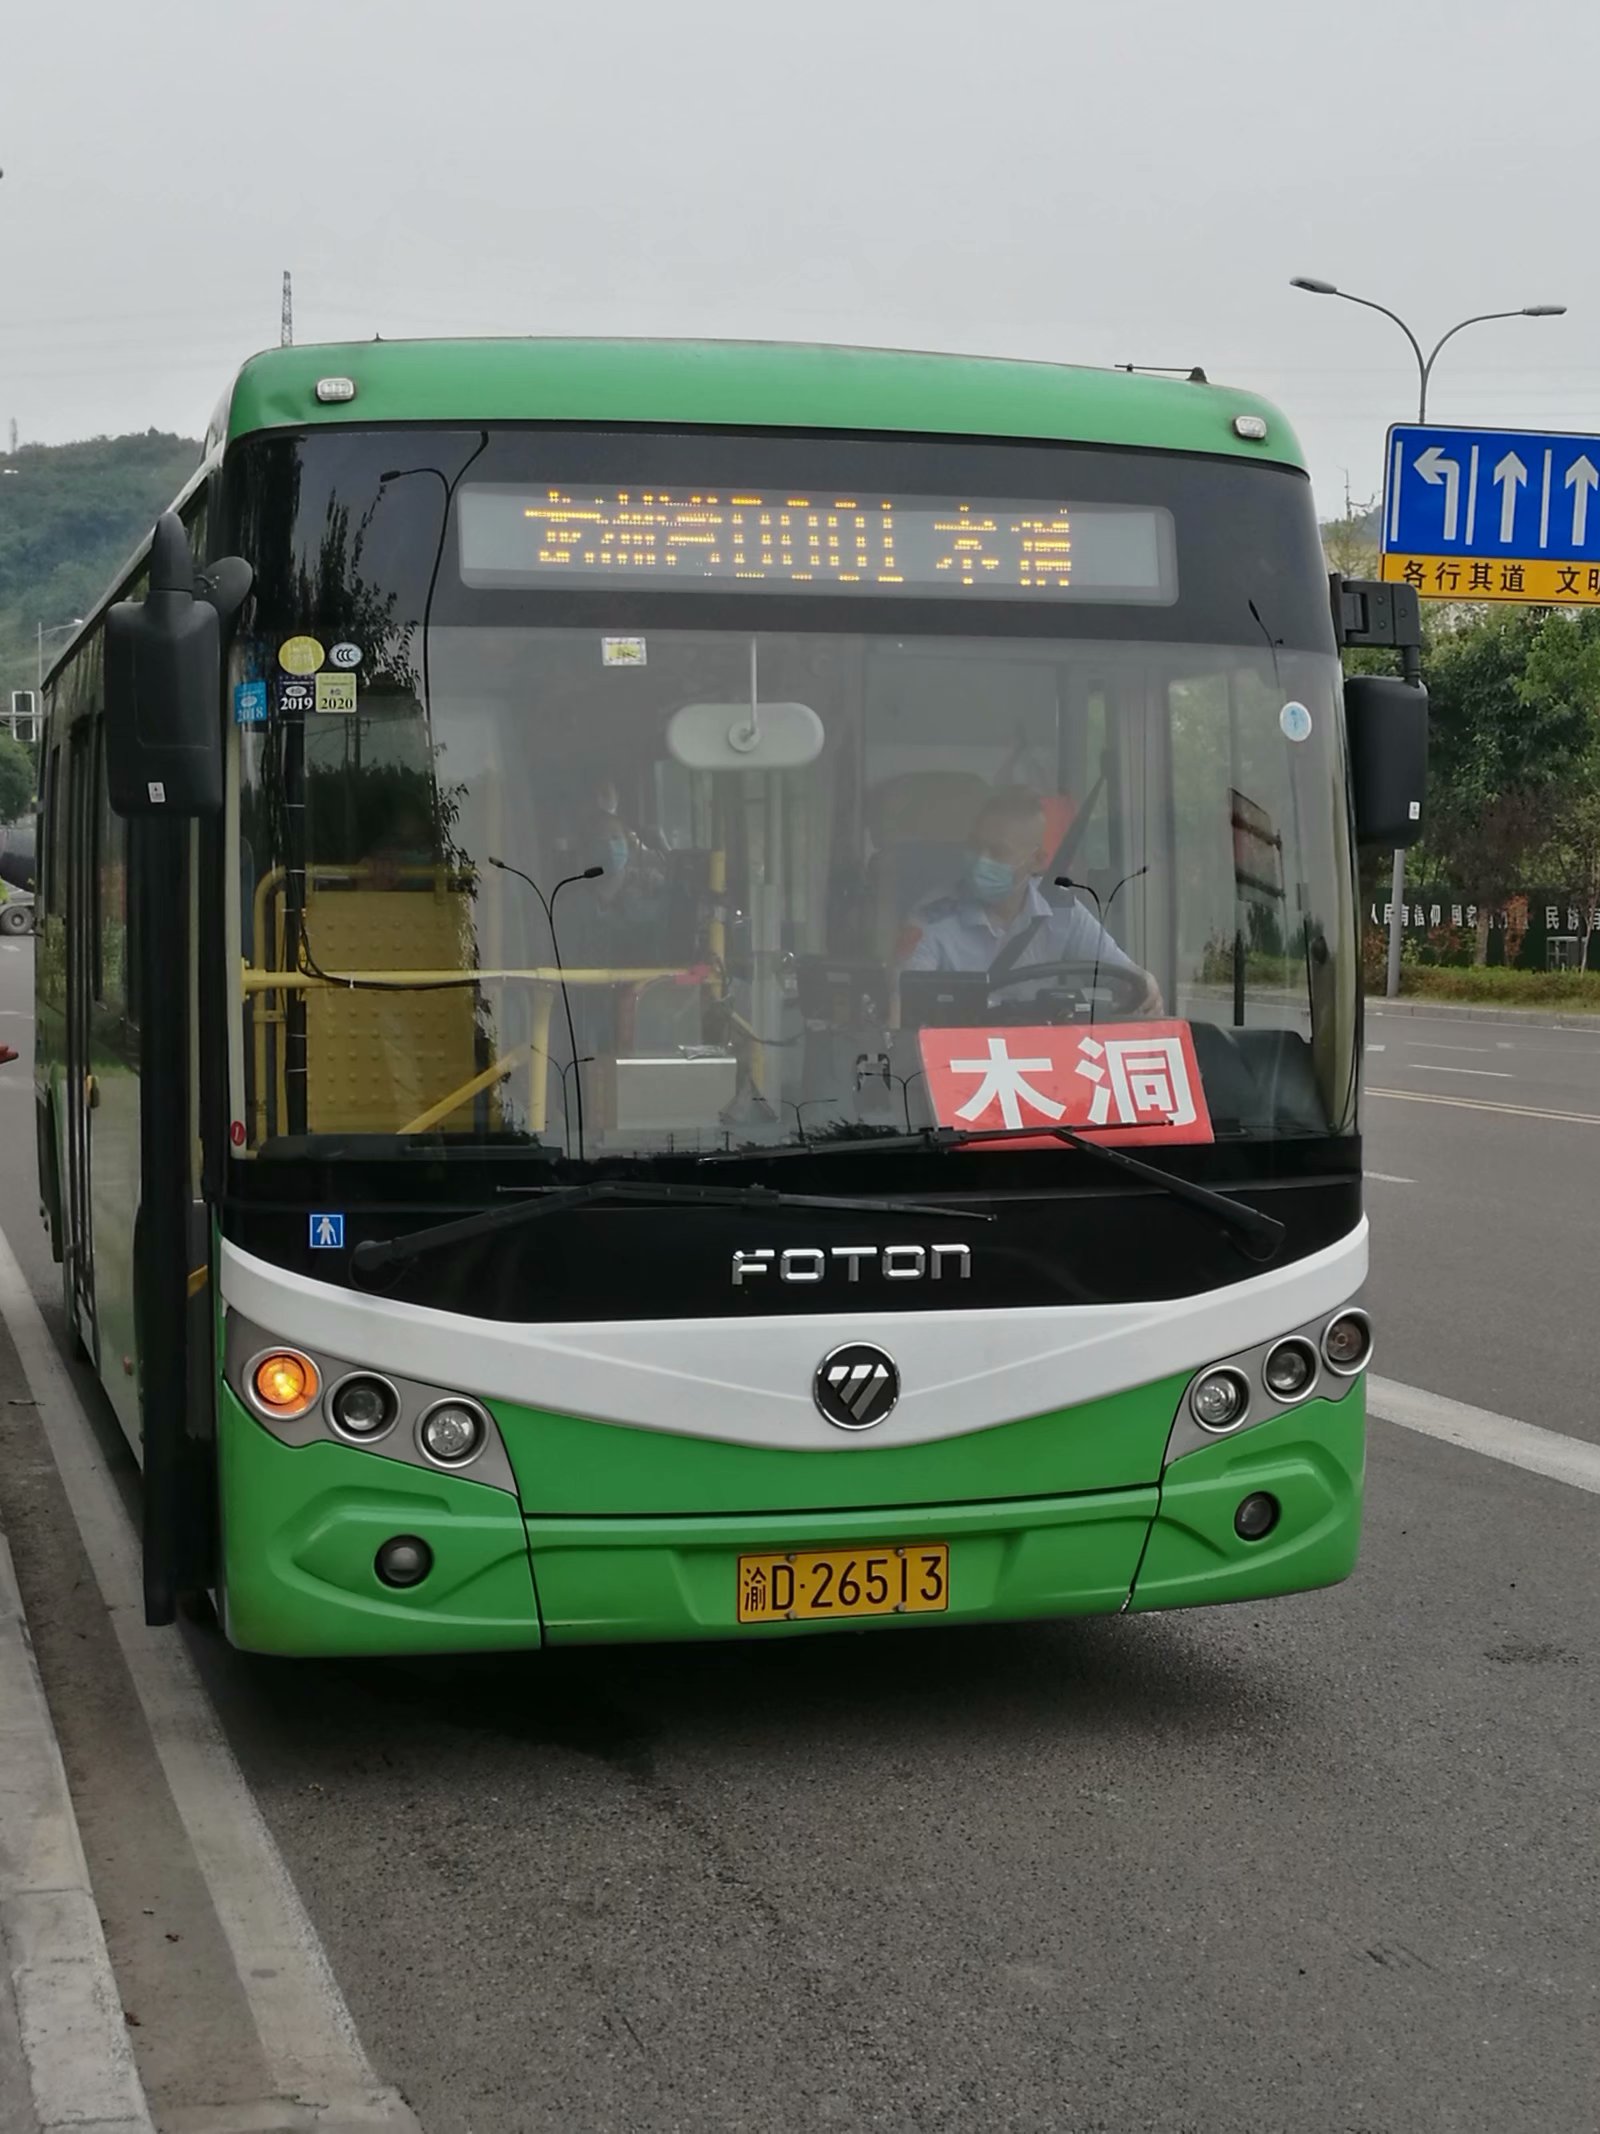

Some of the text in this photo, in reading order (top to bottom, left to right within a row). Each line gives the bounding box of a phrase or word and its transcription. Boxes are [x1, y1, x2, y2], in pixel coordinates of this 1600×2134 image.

[1403, 560, 1525, 593] 各行其道
[237, 706, 264, 722] 2018
[280, 697, 314, 711] 2019
[321, 698, 354, 710] 2020
[949, 1036, 1198, 1130] 木洞
[731, 1244, 971, 1285] FOTON
[744, 1556, 943, 1612] 渝D·26513
